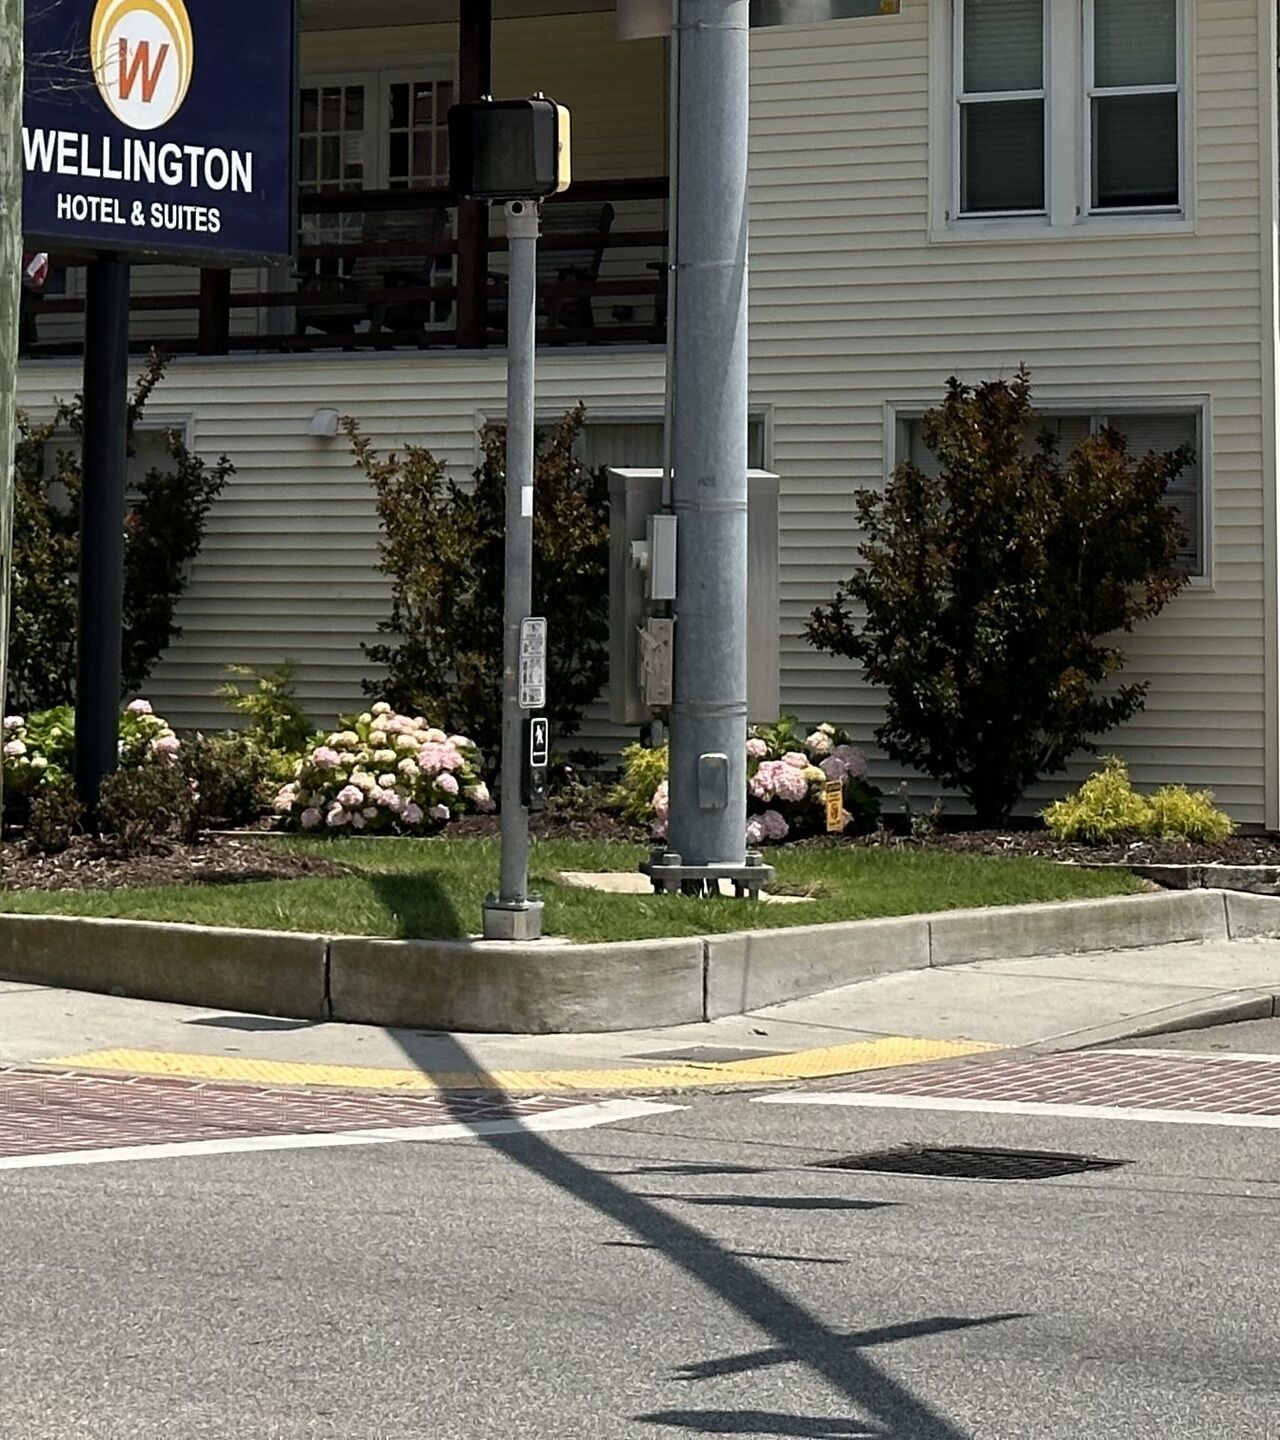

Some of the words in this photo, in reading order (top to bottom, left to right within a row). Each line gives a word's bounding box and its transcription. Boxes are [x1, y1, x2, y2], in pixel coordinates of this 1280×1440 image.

[119, 38, 169, 103] W
[22, 127, 252, 192] WELLINGTON
[57, 193, 126, 224] HOTEL
[131, 201, 145, 226] &
[151, 203, 220, 233] SUITES
